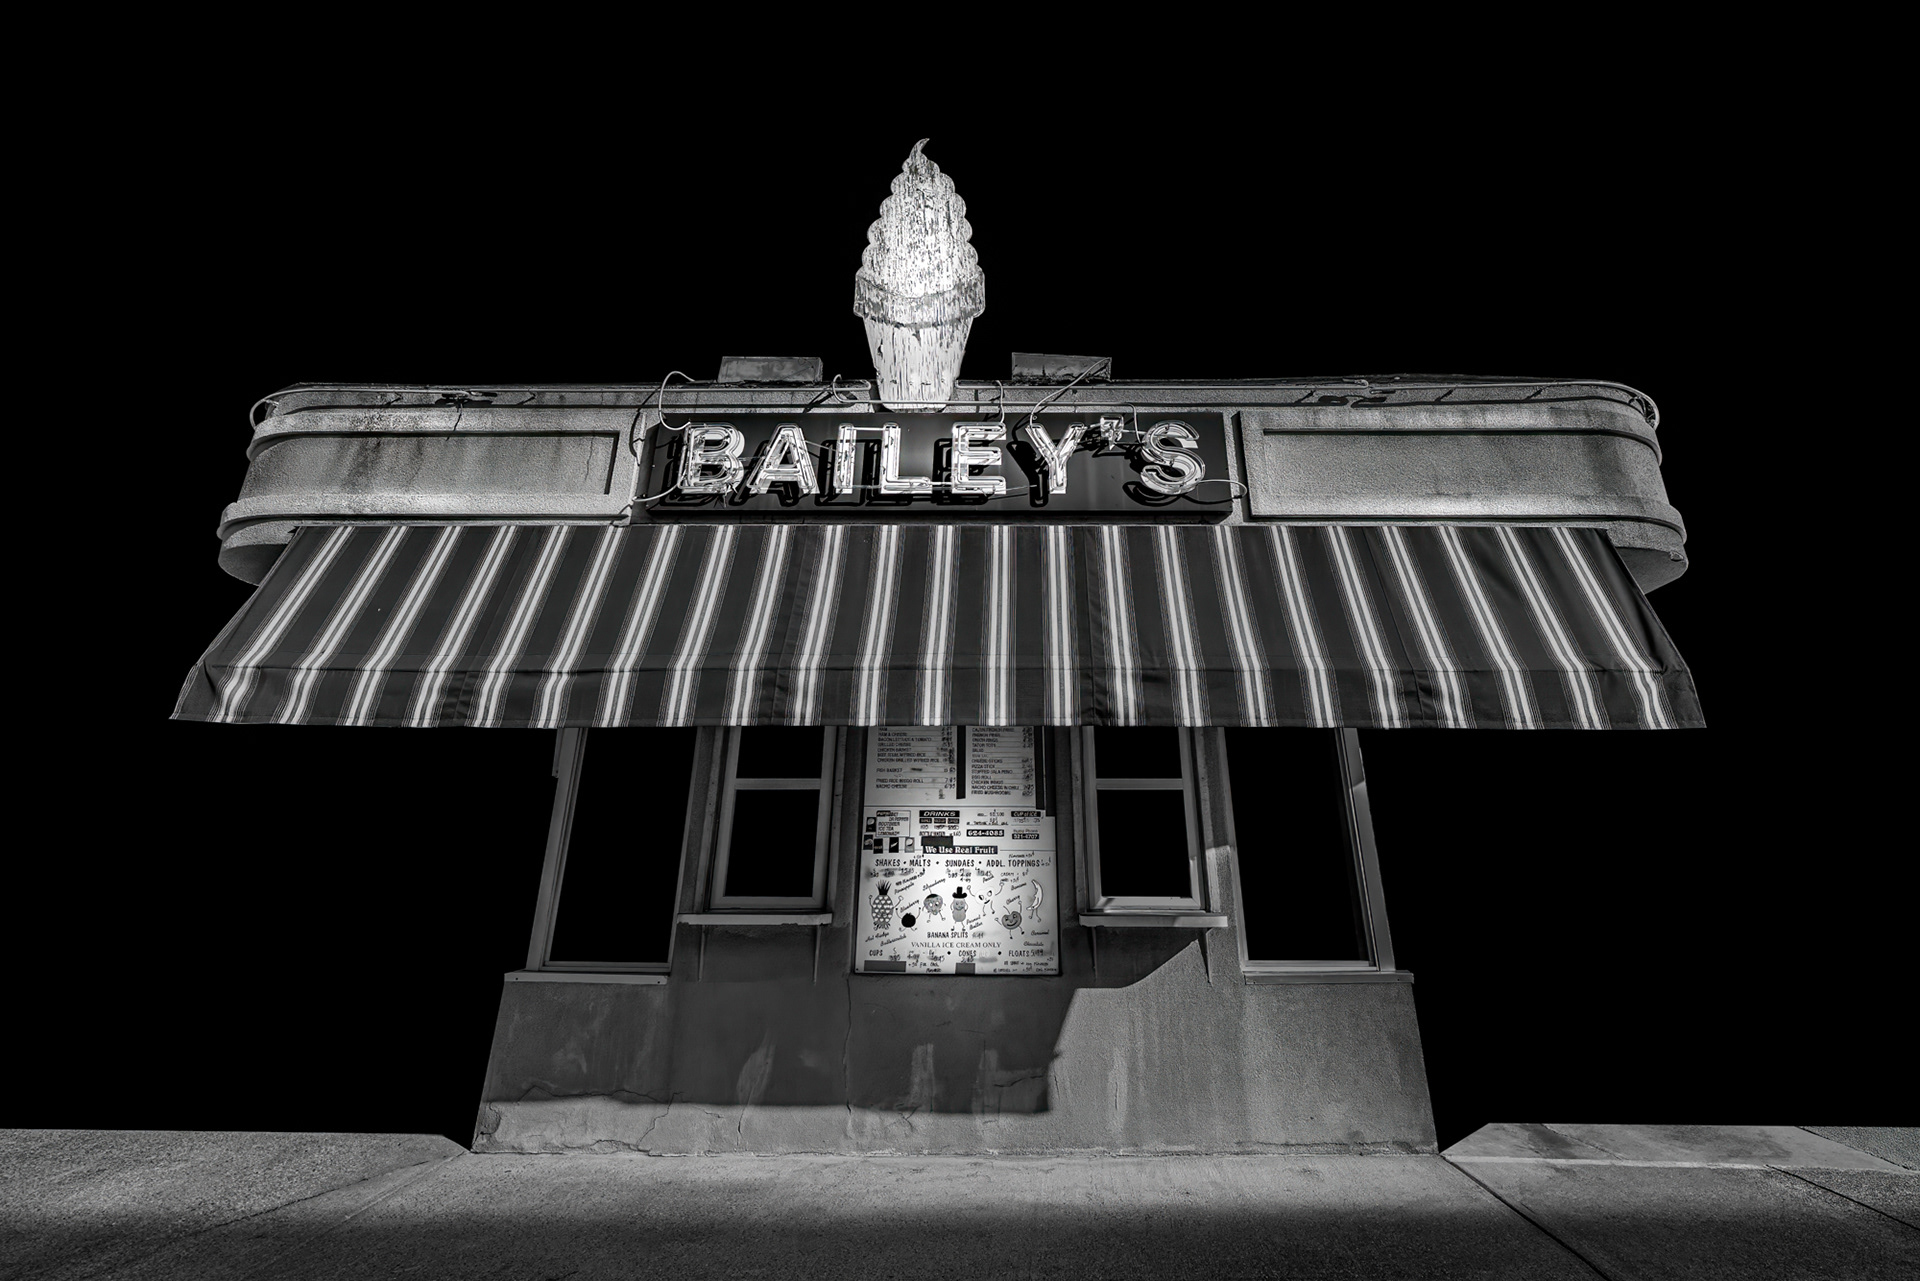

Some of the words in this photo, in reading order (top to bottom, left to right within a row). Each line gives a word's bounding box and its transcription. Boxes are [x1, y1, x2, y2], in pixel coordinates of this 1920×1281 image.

[675, 422, 1206, 496] BAILEY'S
[875, 859, 900, 867] SHAKES
[909, 859, 931, 867] MALTS
[945, 859, 974, 867] SUNDAES
[1008, 859, 1040, 867] TOPPINGS
